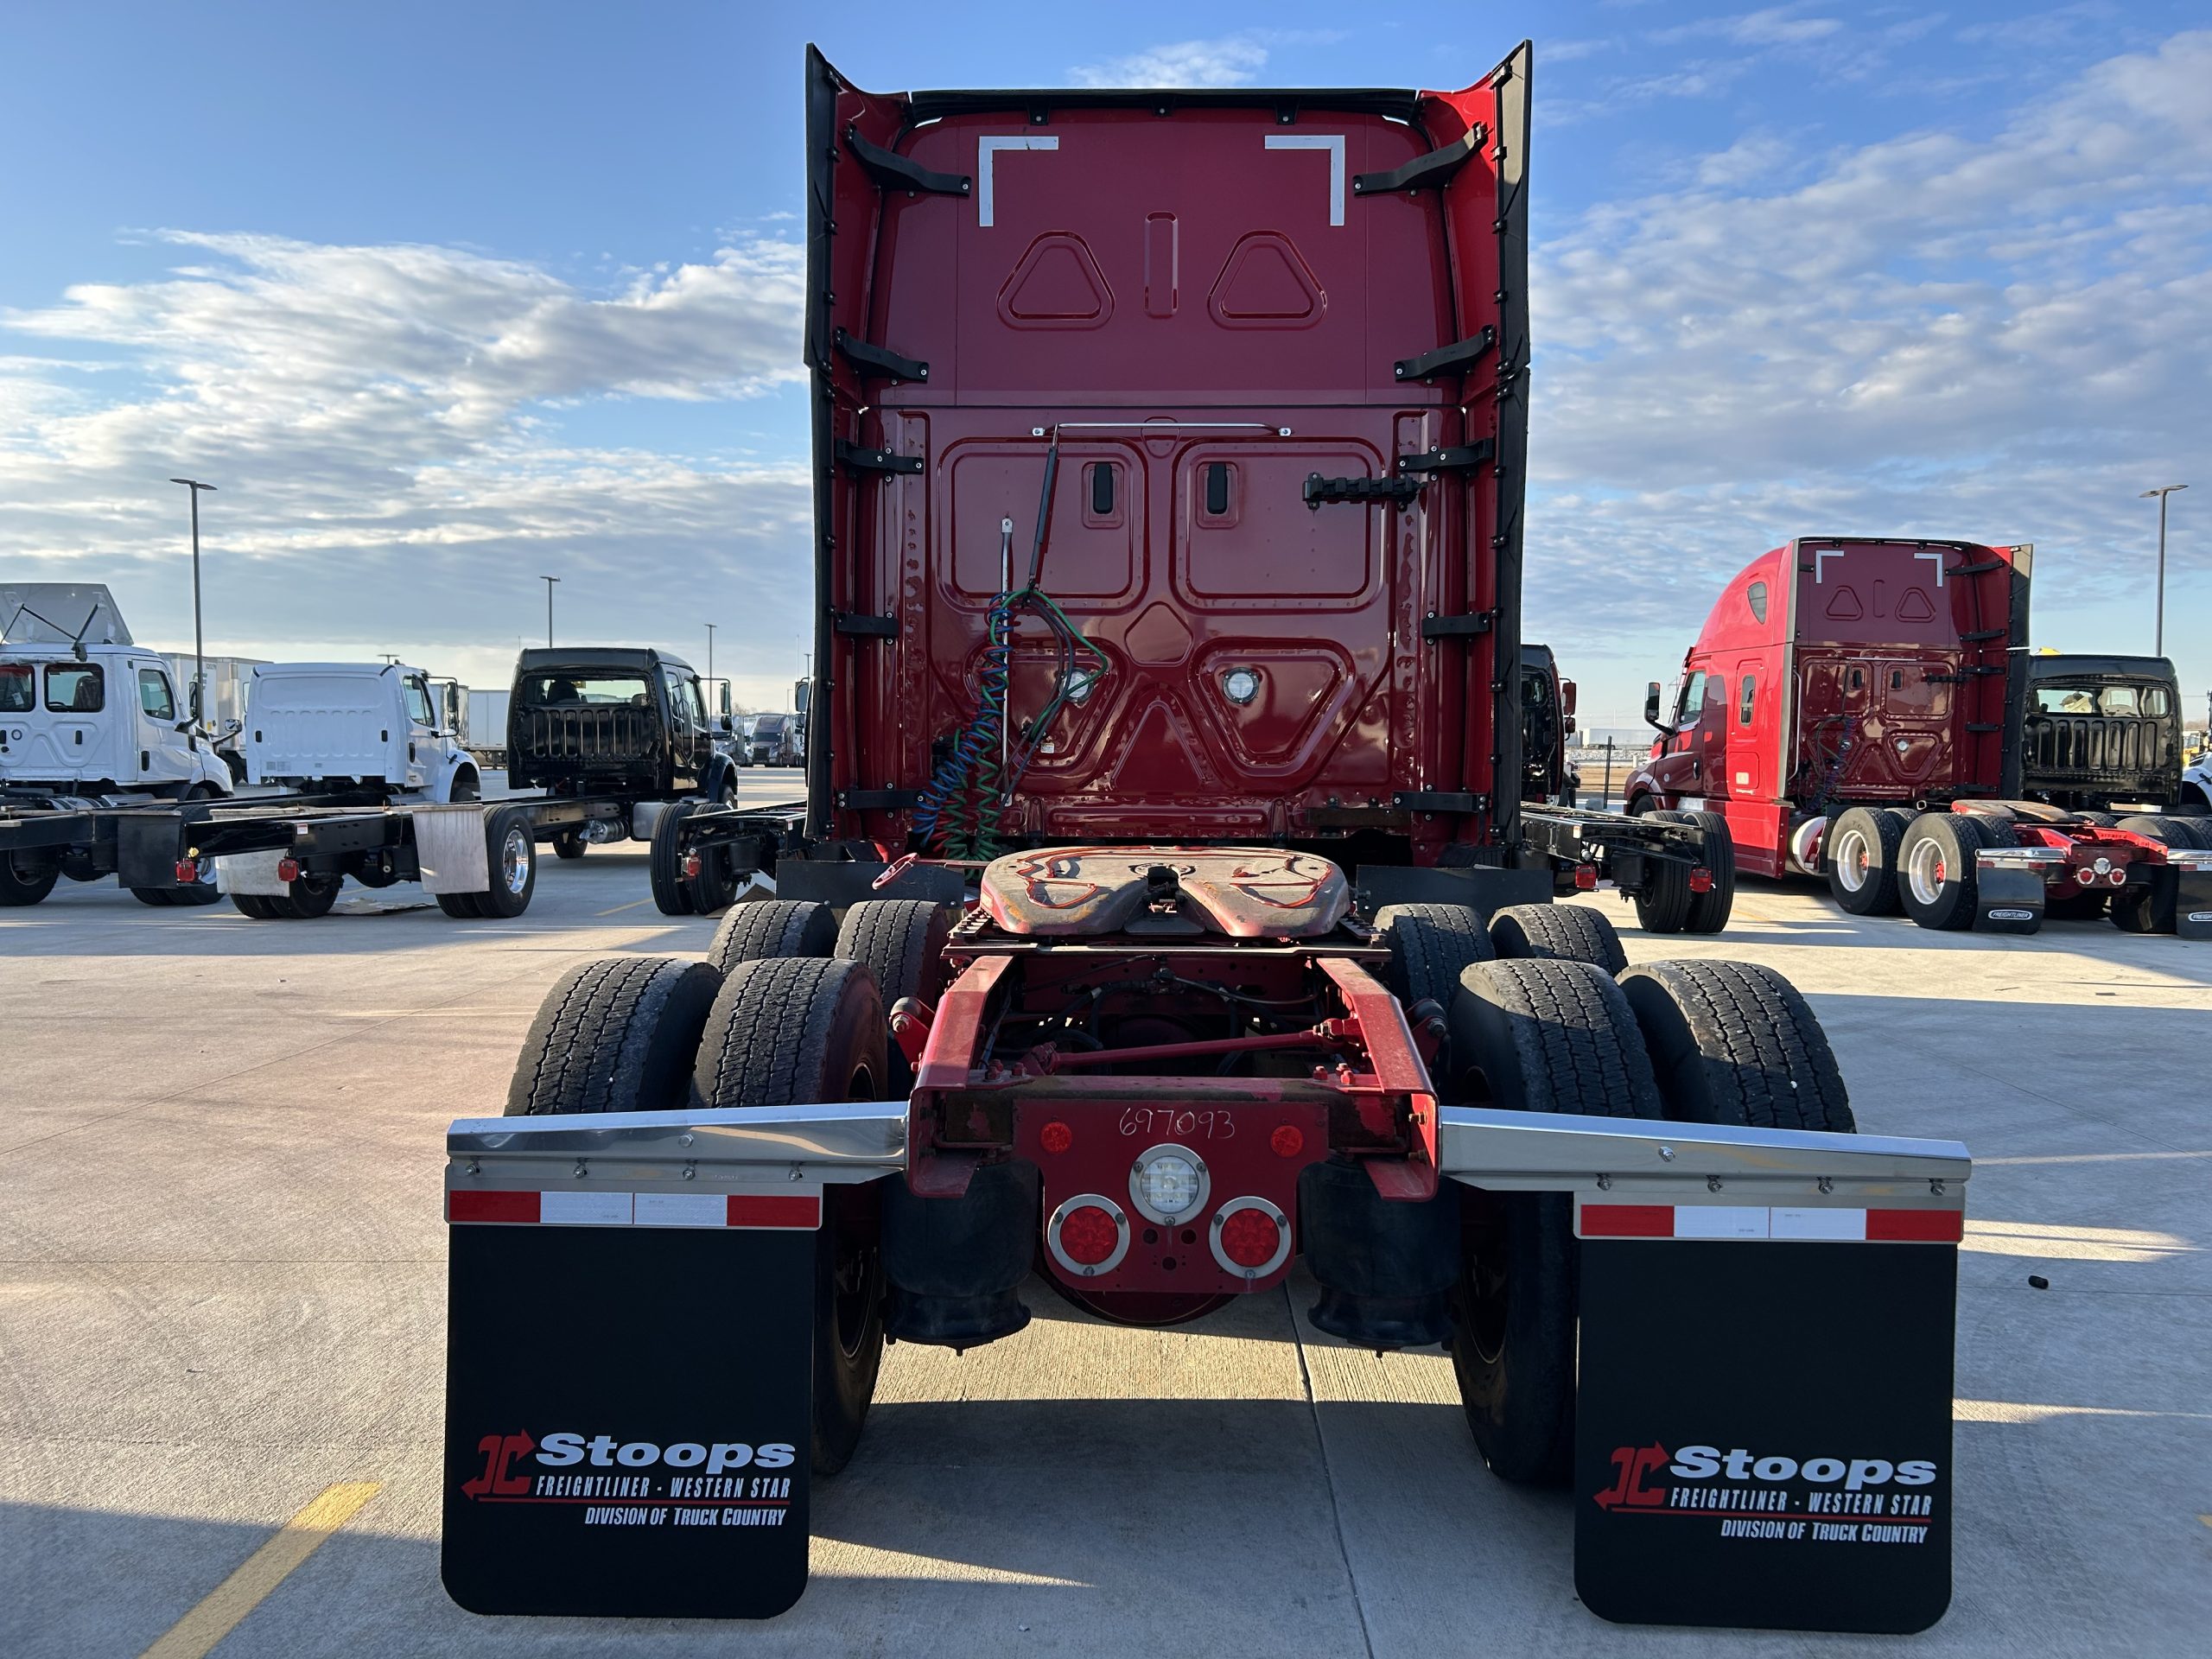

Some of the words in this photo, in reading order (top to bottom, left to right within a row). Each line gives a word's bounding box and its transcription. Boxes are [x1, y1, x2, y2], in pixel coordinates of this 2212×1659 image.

[1119, 1107, 1236, 1139] 697093
[536, 1433, 796, 1474] Stoops
[1669, 1445, 1937, 1491] Stoops
[536, 1475, 650, 1497] FREIGHTLINER
[670, 1477, 744, 1498] WESTERN
[750, 1477, 791, 1498] STAR
[1669, 1487, 1788, 1511] FREIGHTLINER
[1808, 1491, 1885, 1515] WESTERN
[1891, 1494, 1932, 1516] STAR
[584, 1507, 648, 1525] DIVISION
[649, 1507, 668, 1525] OF
[673, 1507, 719, 1526] TRUCK
[721, 1508, 787, 1526] COUNTRY
[1720, 1519, 1786, 1539] DIVISION
[1787, 1521, 1807, 1540] OF
[1811, 1522, 1859, 1541] TRUCK
[1861, 1523, 1929, 1543] COUNTRY
